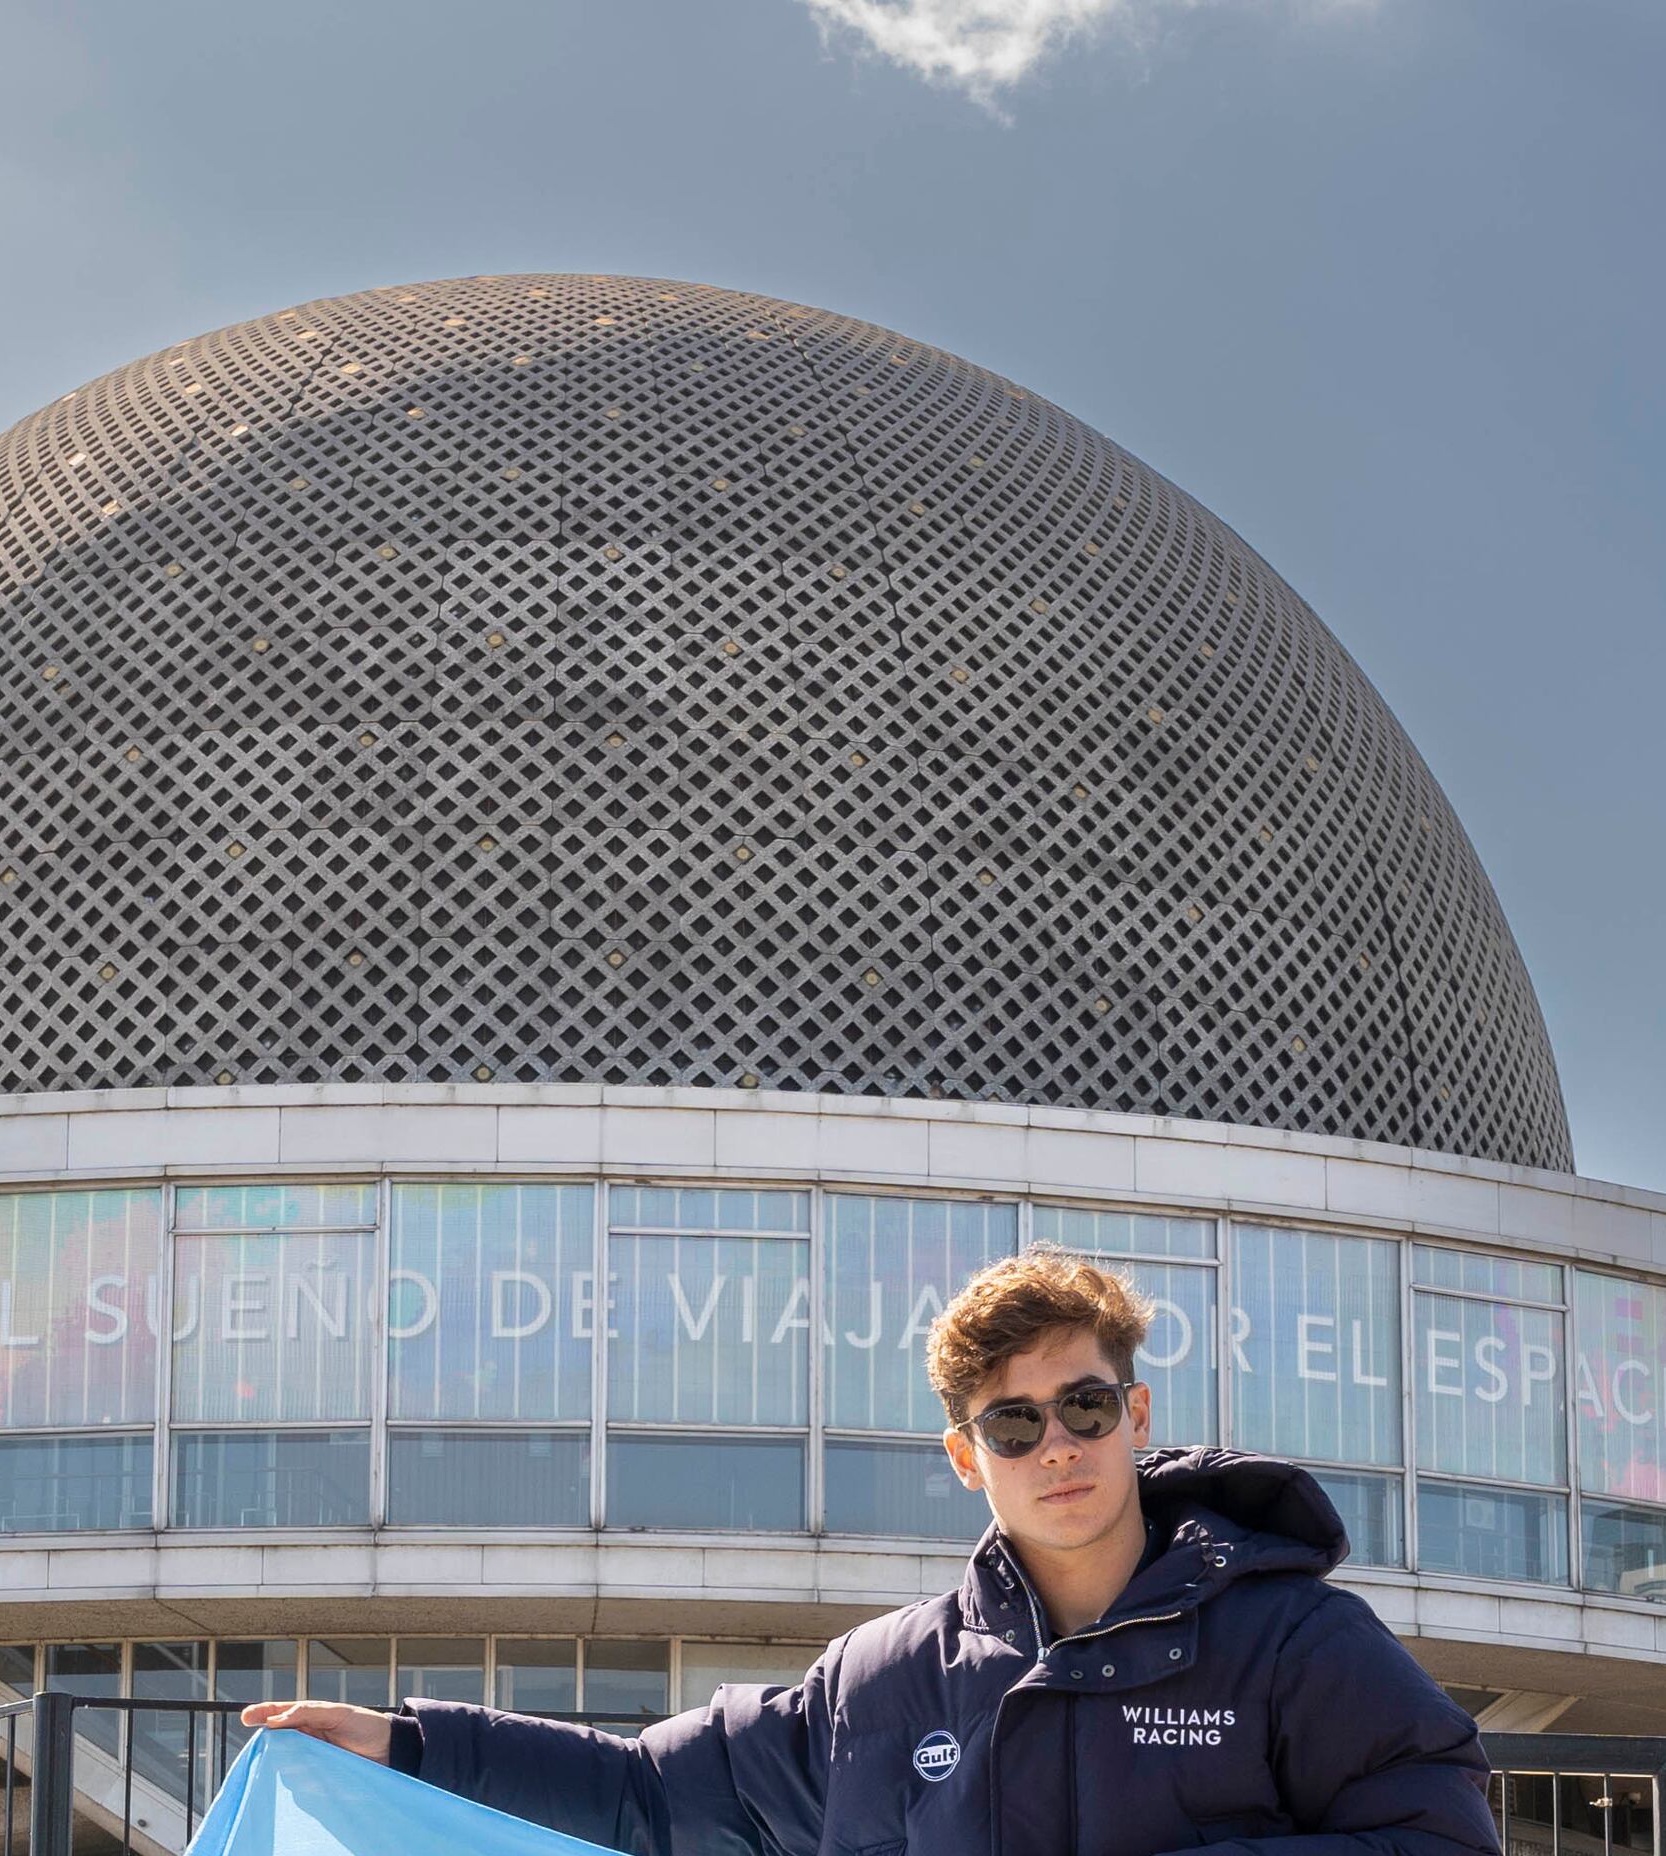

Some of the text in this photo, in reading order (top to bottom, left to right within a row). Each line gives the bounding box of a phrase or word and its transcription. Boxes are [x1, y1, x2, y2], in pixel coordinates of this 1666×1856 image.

[84, 1258, 439, 1346] SUEÑO
[490, 1269, 620, 1340] DE
[667, 1272, 939, 1349] VIAJA
[1296, 1313, 1388, 1387] EL
[1121, 1704, 1236, 1726] WILLIAMS
[1133, 1726, 1222, 1746] RACING
[916, 1746, 958, 1767] Gulf
